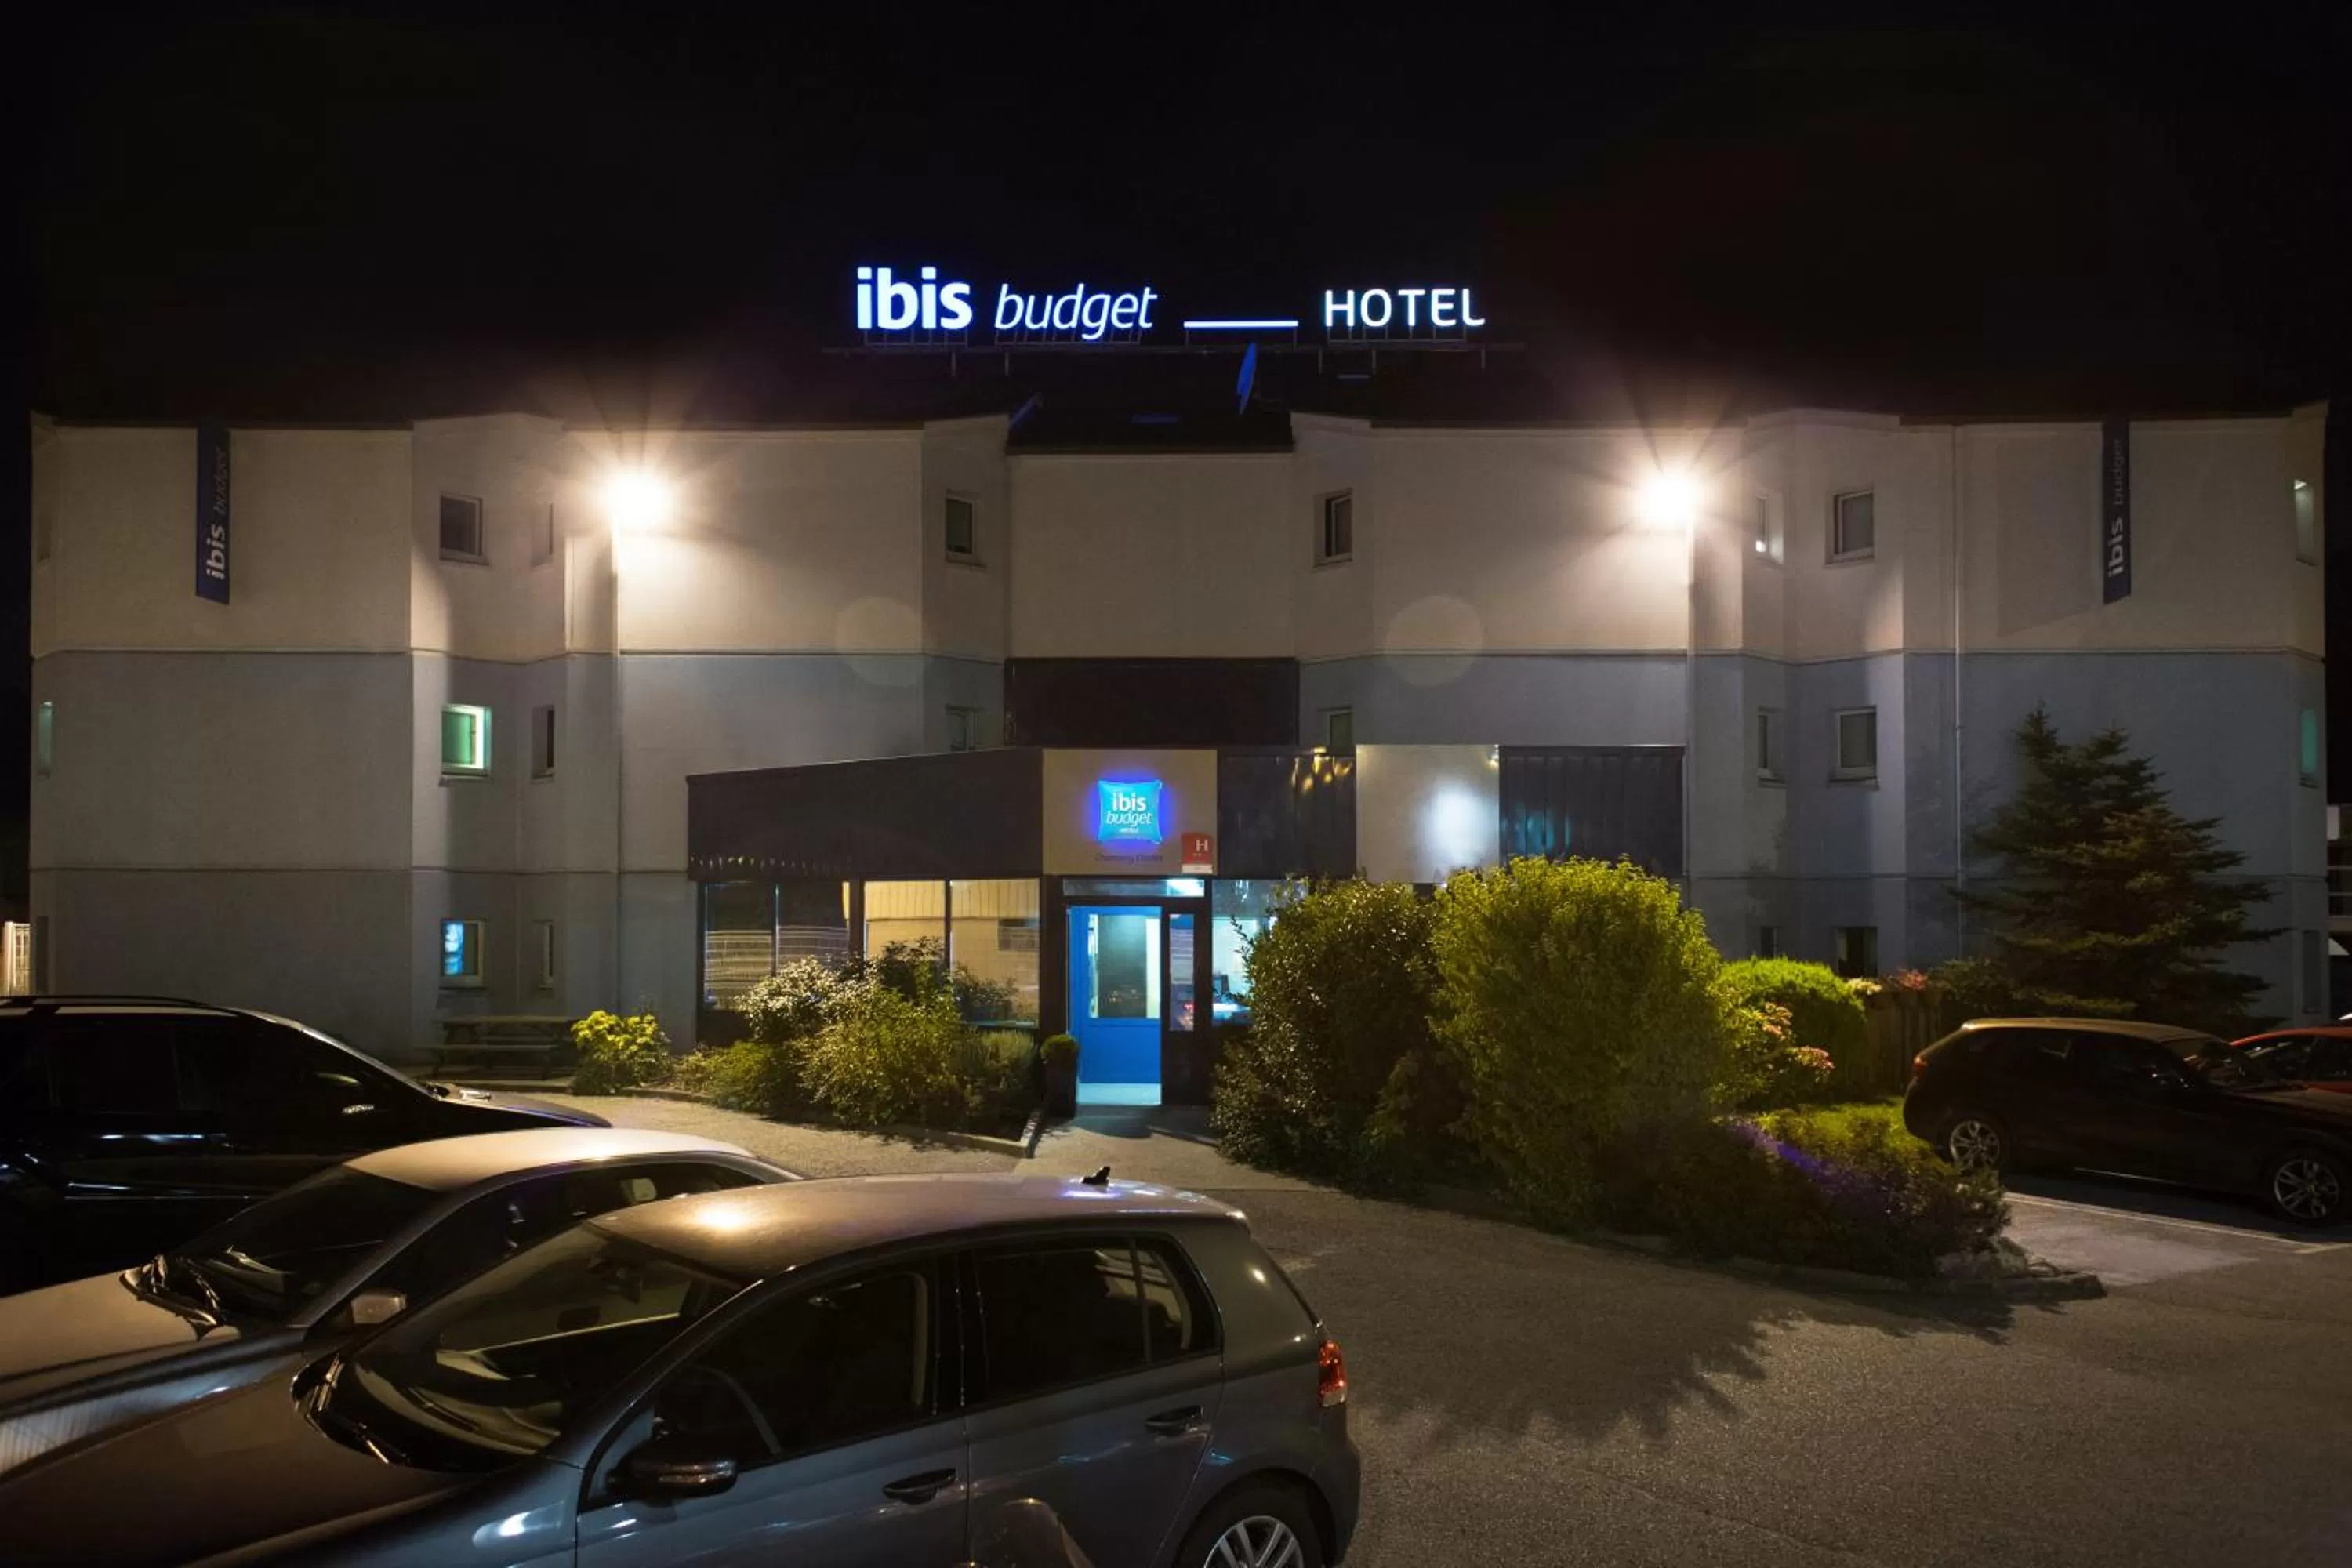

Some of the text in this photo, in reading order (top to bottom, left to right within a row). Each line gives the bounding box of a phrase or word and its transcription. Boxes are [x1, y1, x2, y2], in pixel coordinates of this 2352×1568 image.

[857, 266, 1486, 340] ibis budget HOTEL
[205, 524, 226, 580] ibis
[2108, 517, 2124, 578] ibis
[1106, 811, 1153, 827] budget
[1112, 793, 1147, 811] ibis
[1196, 840, 1209, 852] H
